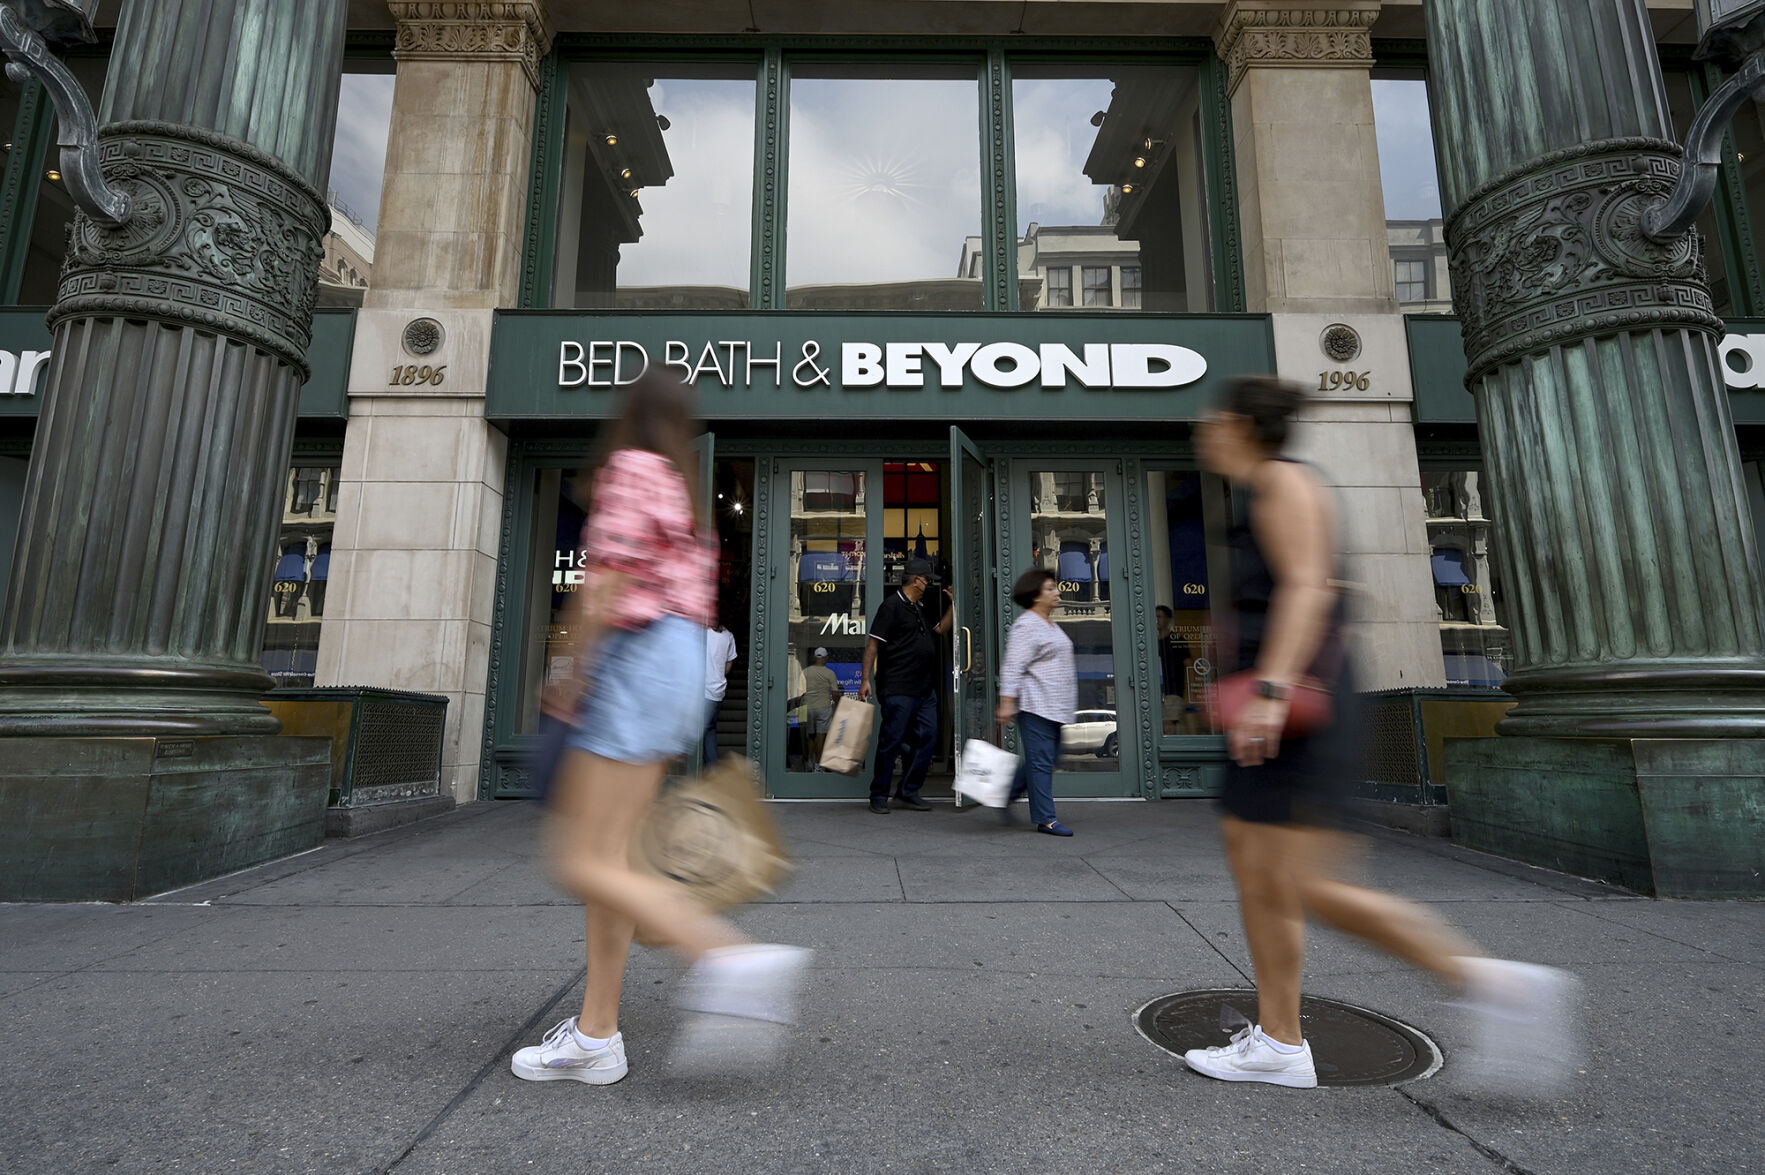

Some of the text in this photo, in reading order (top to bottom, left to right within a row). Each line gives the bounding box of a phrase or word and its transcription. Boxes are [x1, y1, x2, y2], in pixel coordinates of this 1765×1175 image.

[558, 340, 1207, 389] BED BATH & BEYOND
[389, 365, 447, 386] 1896
[1318, 371, 1371, 391] 1996
[274, 581, 297, 593] 620
[555, 583, 577, 593] 620
[813, 581, 836, 593] 620
[1058, 580, 1080, 592] 620
[1183, 582, 1205, 595] 620
